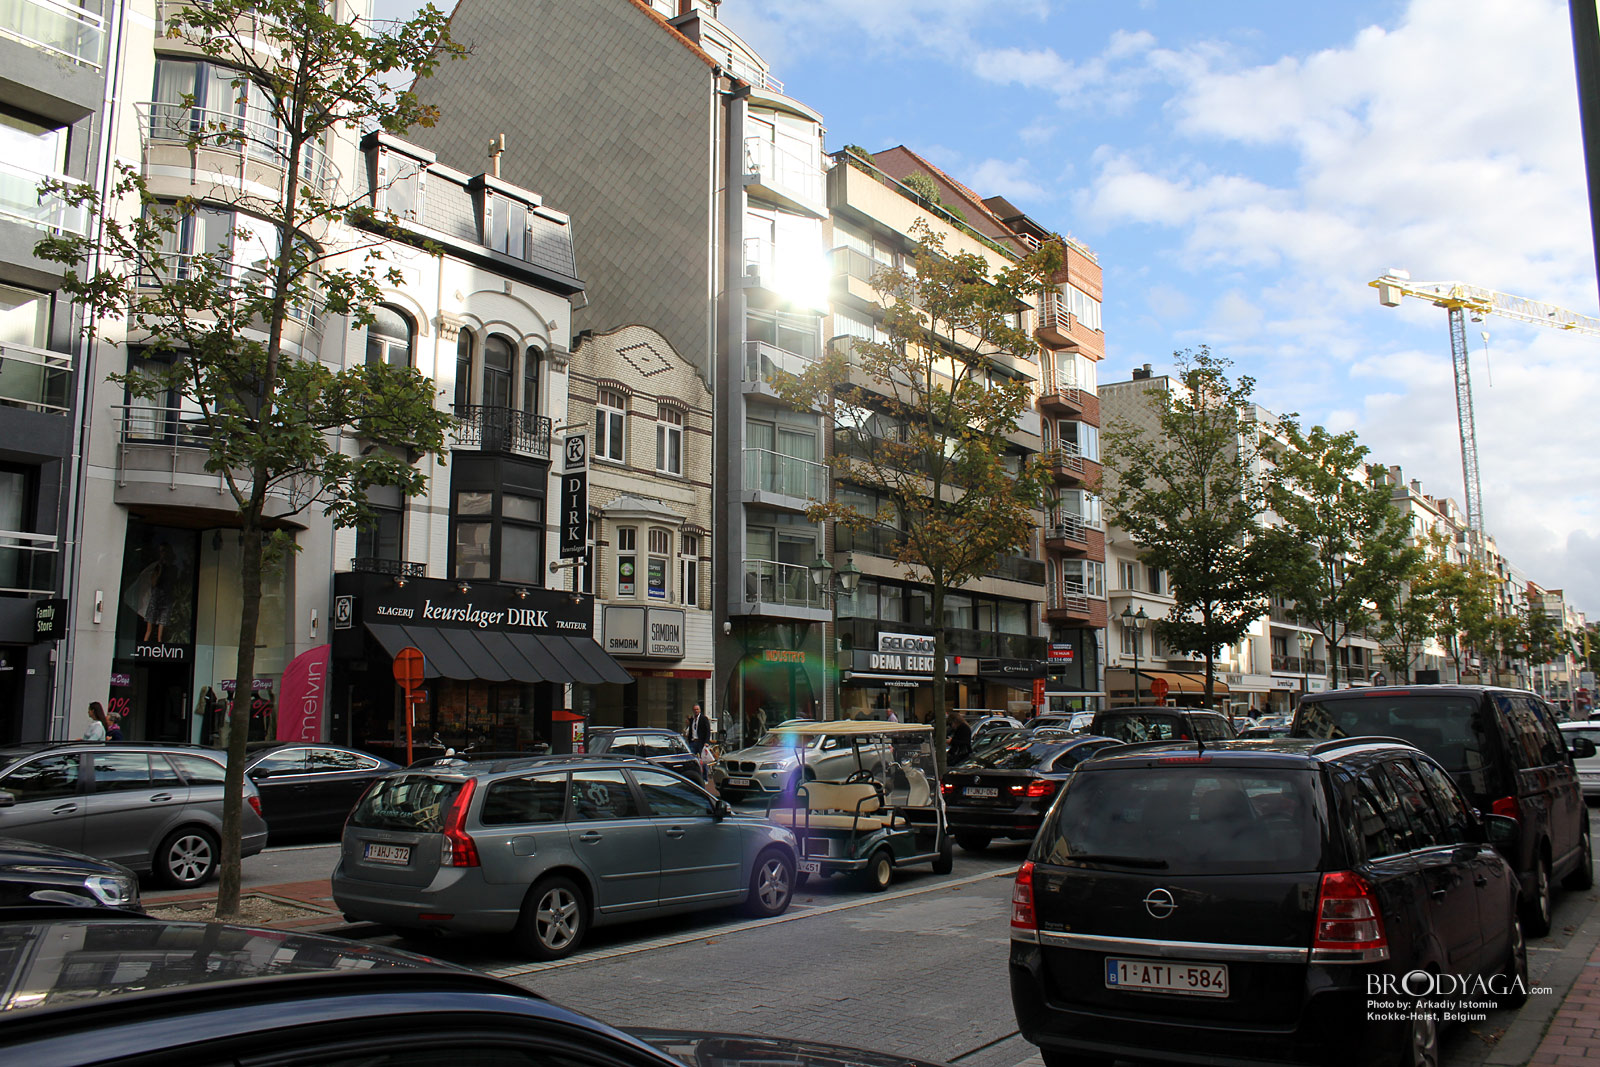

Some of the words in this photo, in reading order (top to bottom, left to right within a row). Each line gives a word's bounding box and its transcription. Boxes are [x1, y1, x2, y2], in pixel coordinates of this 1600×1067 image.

[569, 478, 580, 541] DIRK
[36, 605, 55, 620] Family
[377, 606, 414, 619] SLAGERIJ
[422, 599, 504, 628] keurslager
[507, 607, 549, 627] DIRK
[556, 620, 587, 630] TRAITEUR
[37, 620, 53, 632] Store
[652, 622, 679, 642] SAMDAM
[610, 638, 638, 648] SAMDAM
[871, 653, 901, 670] DEMA
[906, 656, 949, 672] ELEKTO
[252, 679, 272, 689] Days
[1110, 973, 1117, 982] B
